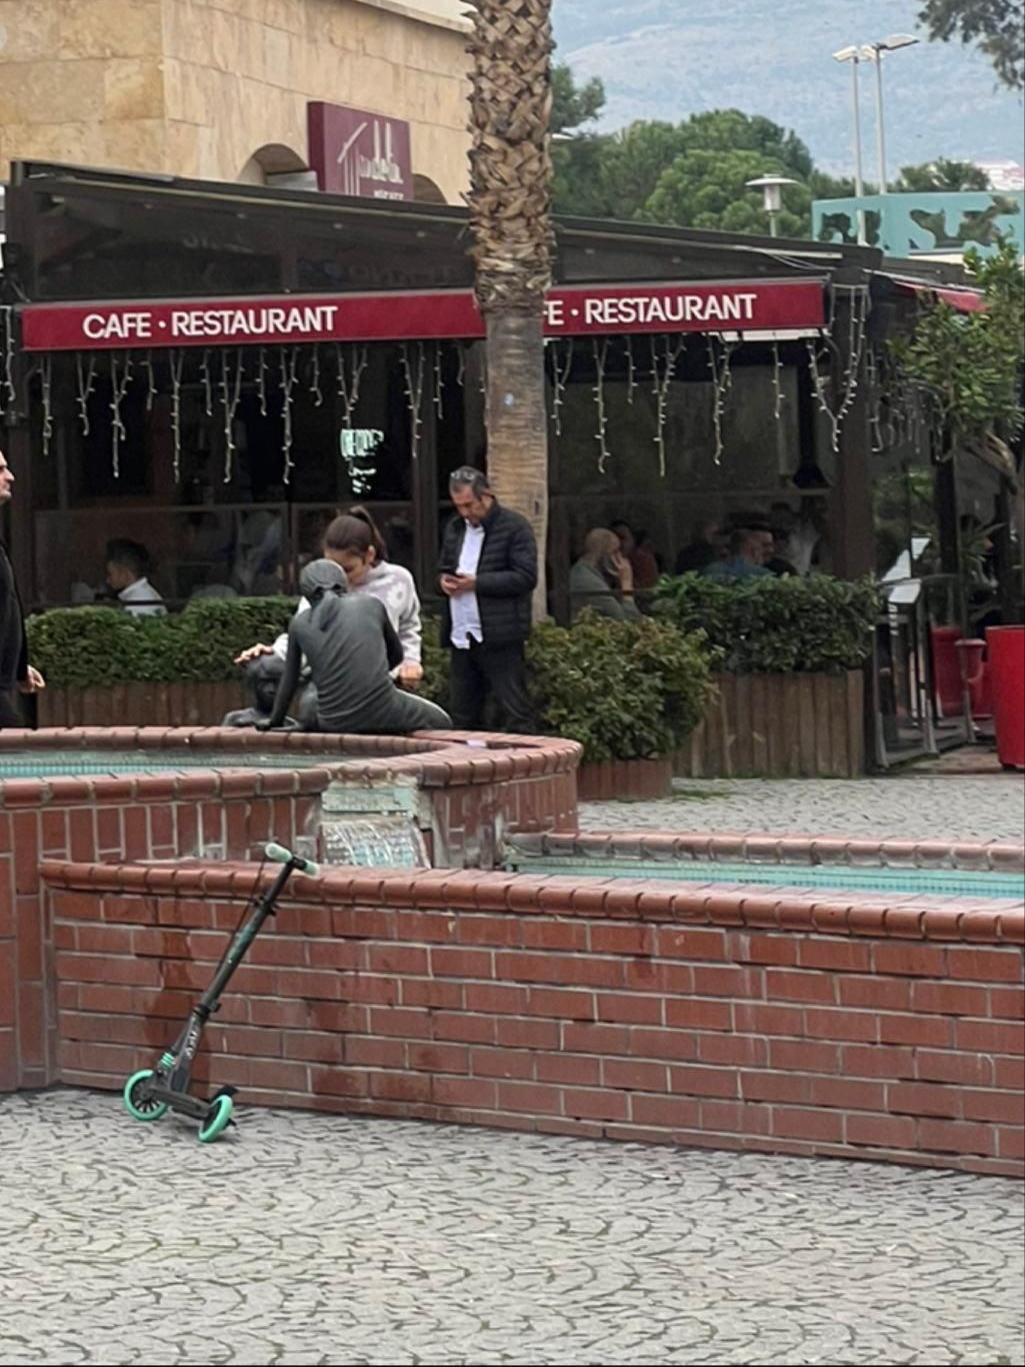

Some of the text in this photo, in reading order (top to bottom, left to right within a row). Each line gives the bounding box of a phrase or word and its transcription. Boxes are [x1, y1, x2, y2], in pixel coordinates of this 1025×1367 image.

[82, 305, 337, 339] CAFE RESTAURANT
[584, 294, 757, 324] RESTAURANT
